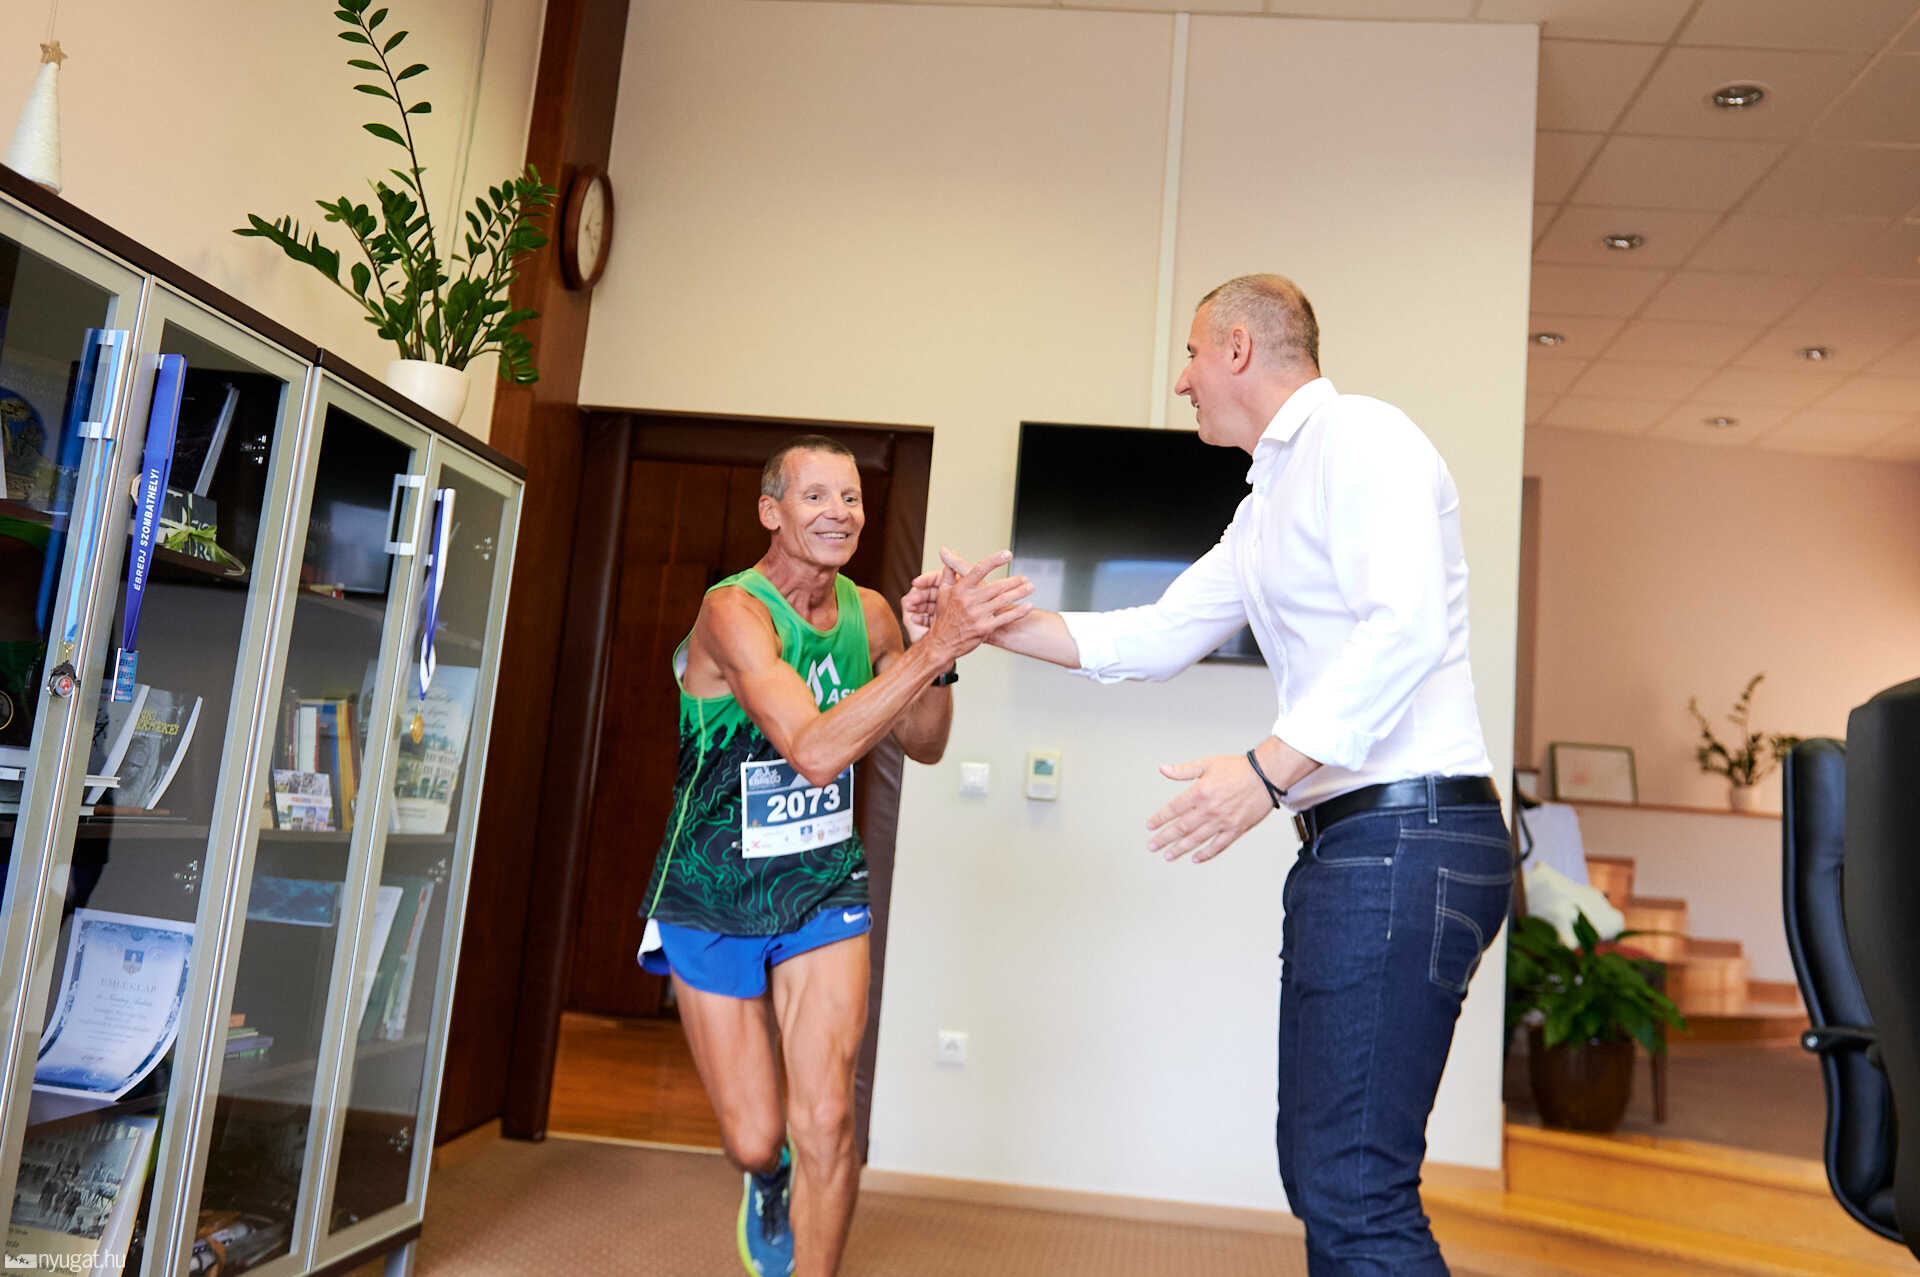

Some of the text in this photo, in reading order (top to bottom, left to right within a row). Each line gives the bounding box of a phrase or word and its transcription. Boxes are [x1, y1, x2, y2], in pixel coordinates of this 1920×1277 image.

[133, 468, 160, 591] ÉBREDJ SZOMBATHELY!
[766, 783, 841, 823] 2073
